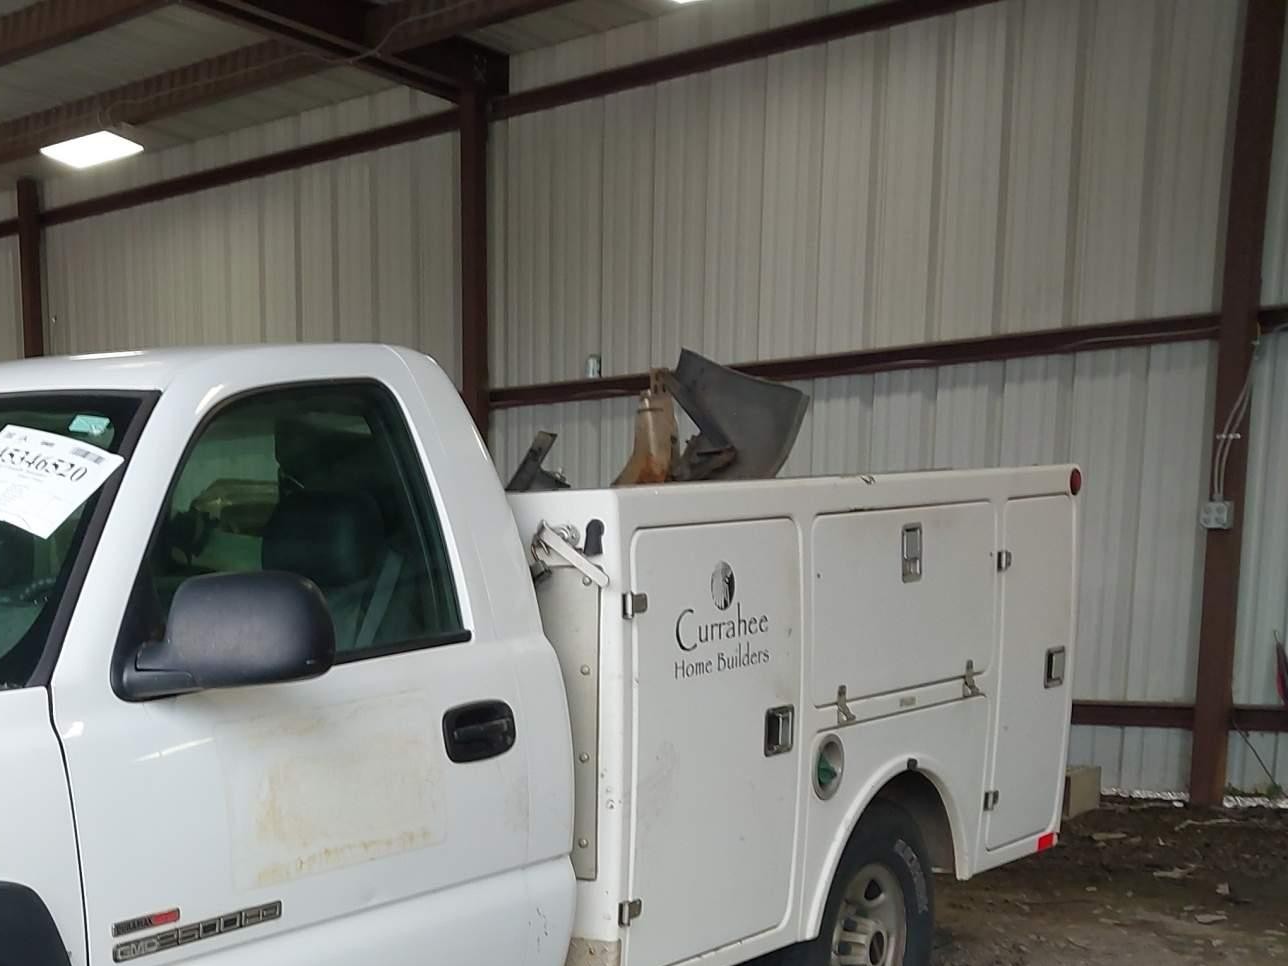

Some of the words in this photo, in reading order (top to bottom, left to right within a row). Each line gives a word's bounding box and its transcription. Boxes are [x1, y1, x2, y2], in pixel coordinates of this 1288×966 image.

[675, 601, 769, 652] Currahee
[674, 659, 713, 679] Home
[717, 641, 770, 672] Builders
